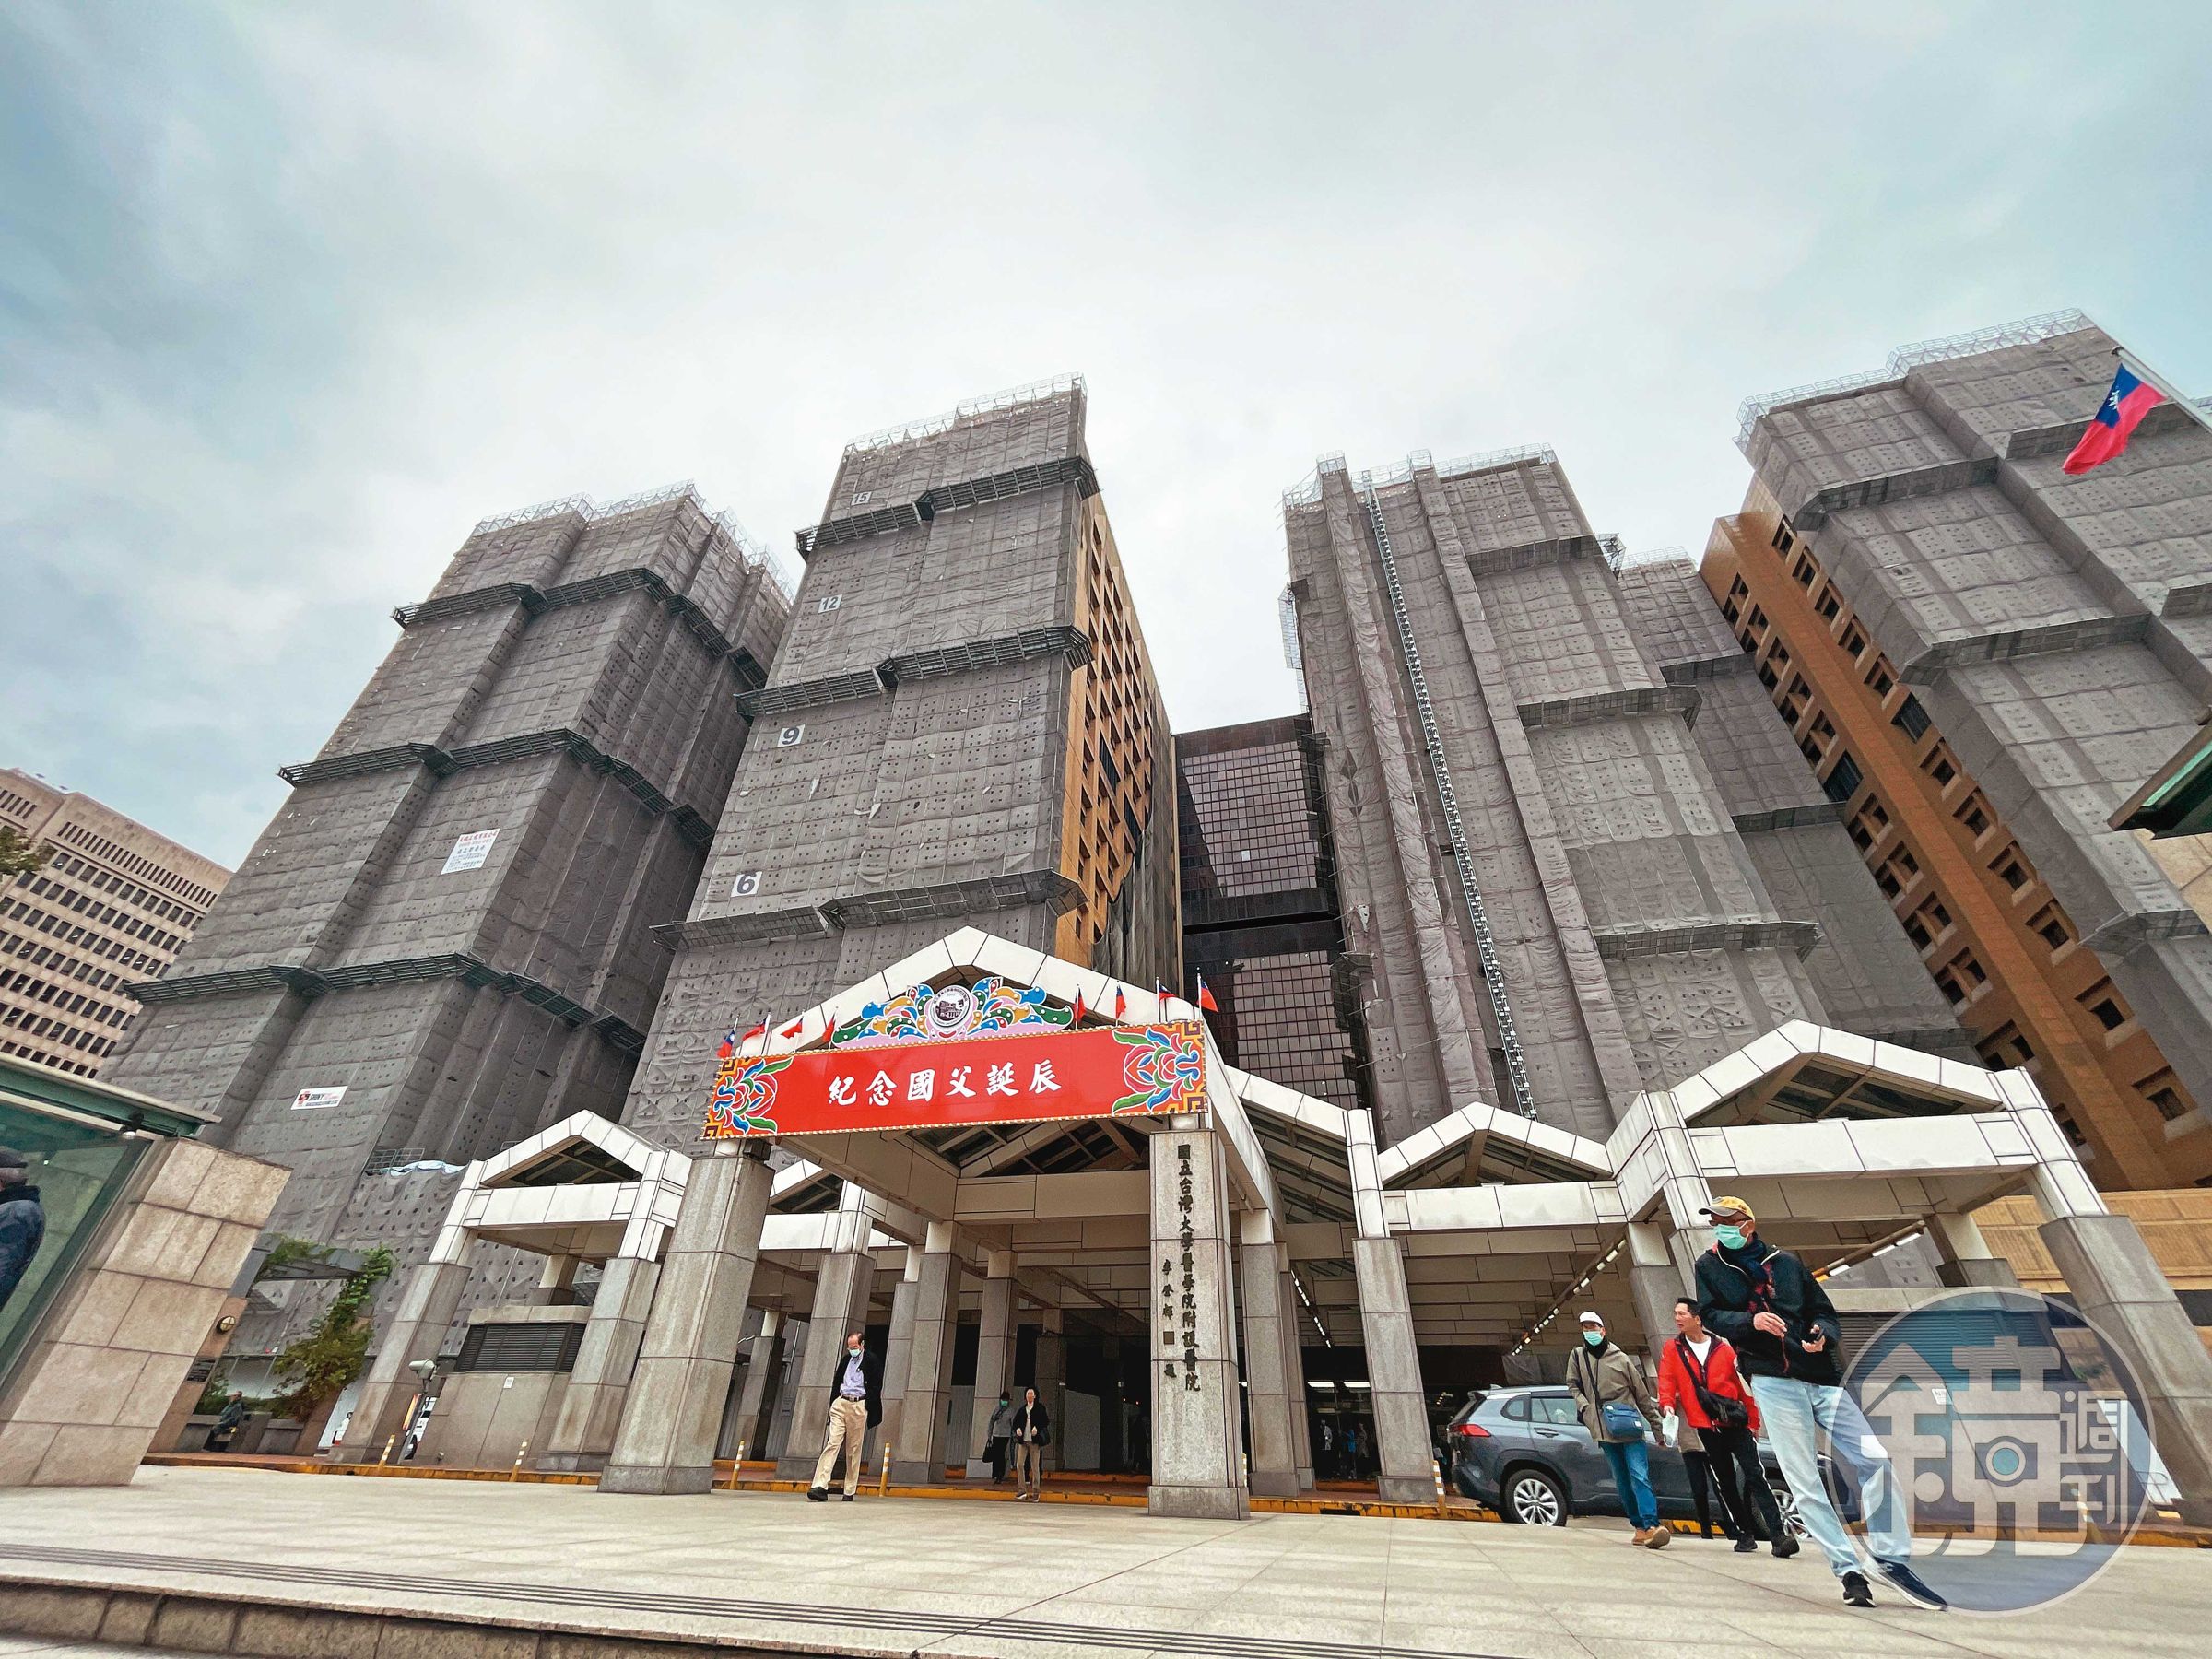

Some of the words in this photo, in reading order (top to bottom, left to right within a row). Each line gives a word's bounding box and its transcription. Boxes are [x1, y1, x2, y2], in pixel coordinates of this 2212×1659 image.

[854, 493, 867, 503] 15
[822, 597, 839, 610] 12
[782, 727, 800, 745] 9
[736, 874, 756, 894] 6
[828, 1059, 1062, 1107] 紀念國父誕辰
